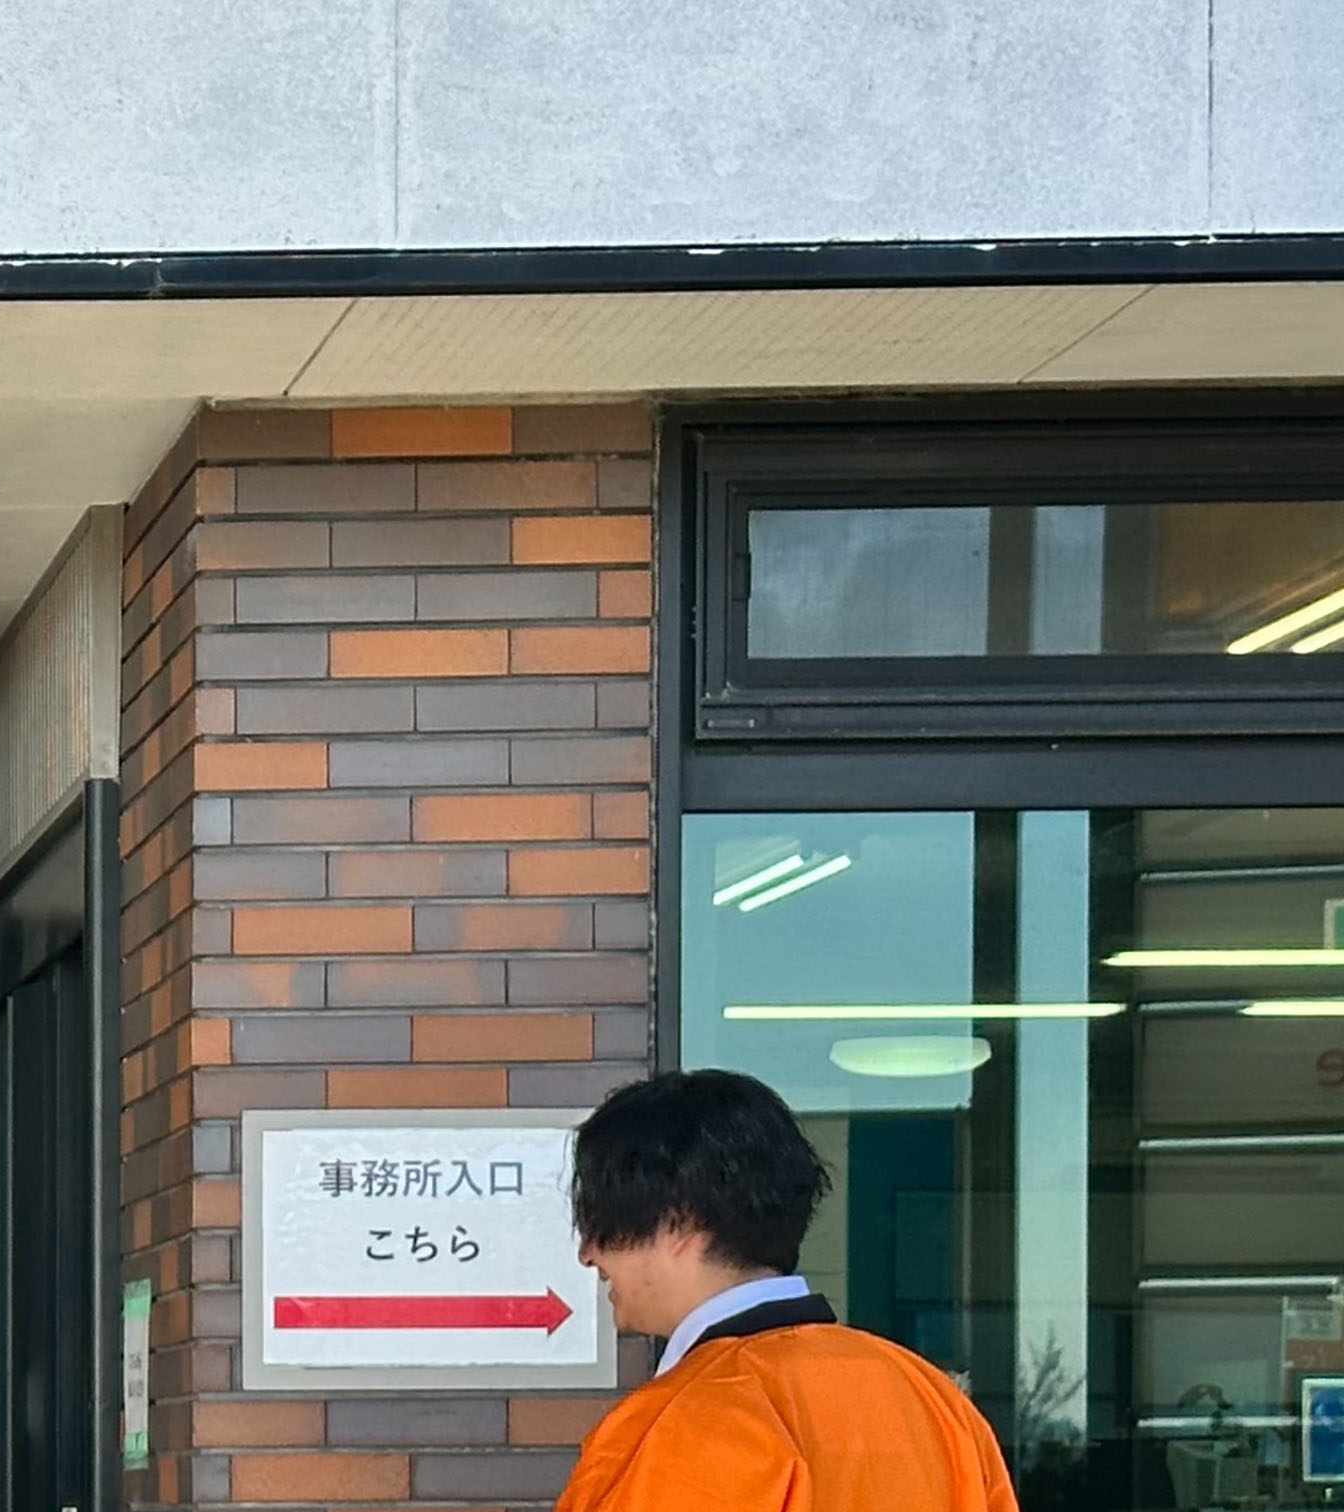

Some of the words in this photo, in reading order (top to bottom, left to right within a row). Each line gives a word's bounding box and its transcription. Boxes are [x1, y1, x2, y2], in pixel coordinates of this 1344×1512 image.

[318, 1158, 524, 1199] 事務所入口
[366, 1225, 481, 1263] こちら
